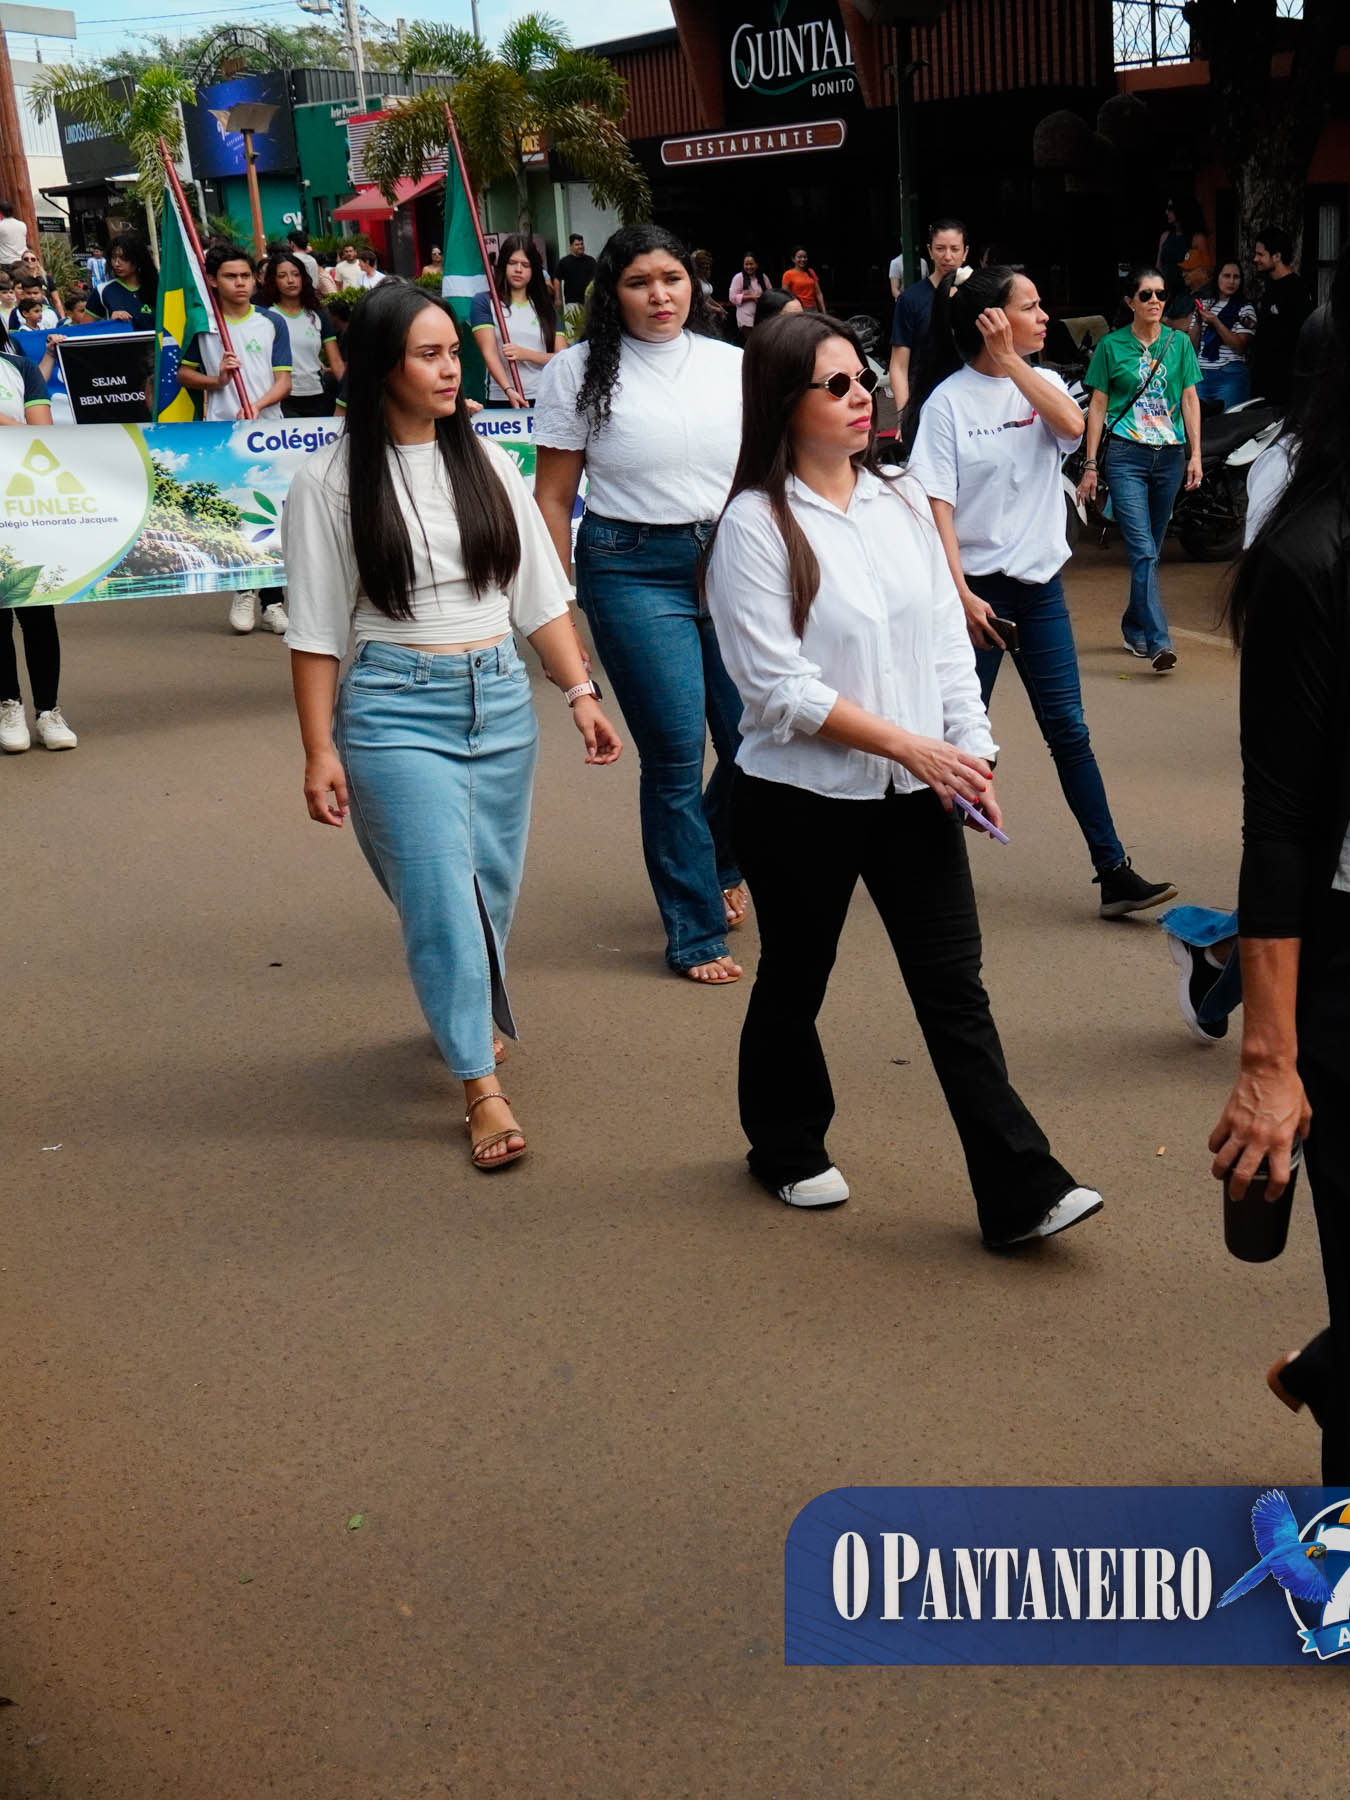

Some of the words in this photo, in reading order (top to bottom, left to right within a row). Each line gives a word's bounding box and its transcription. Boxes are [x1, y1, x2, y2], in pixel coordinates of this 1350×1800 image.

[811, 78, 855, 97] BONITO
[685, 130, 814, 157] RESTAURANTE
[91, 375, 127, 388] SEJAM
[79, 395, 103, 406] BEM
[104, 391, 146, 403] VINDOS
[246, 426, 339, 453] Colégio
[4, 496, 97, 517] FUNLEC
[31, 517, 77, 528] Honorato
[79, 516, 119, 526] Jacques
